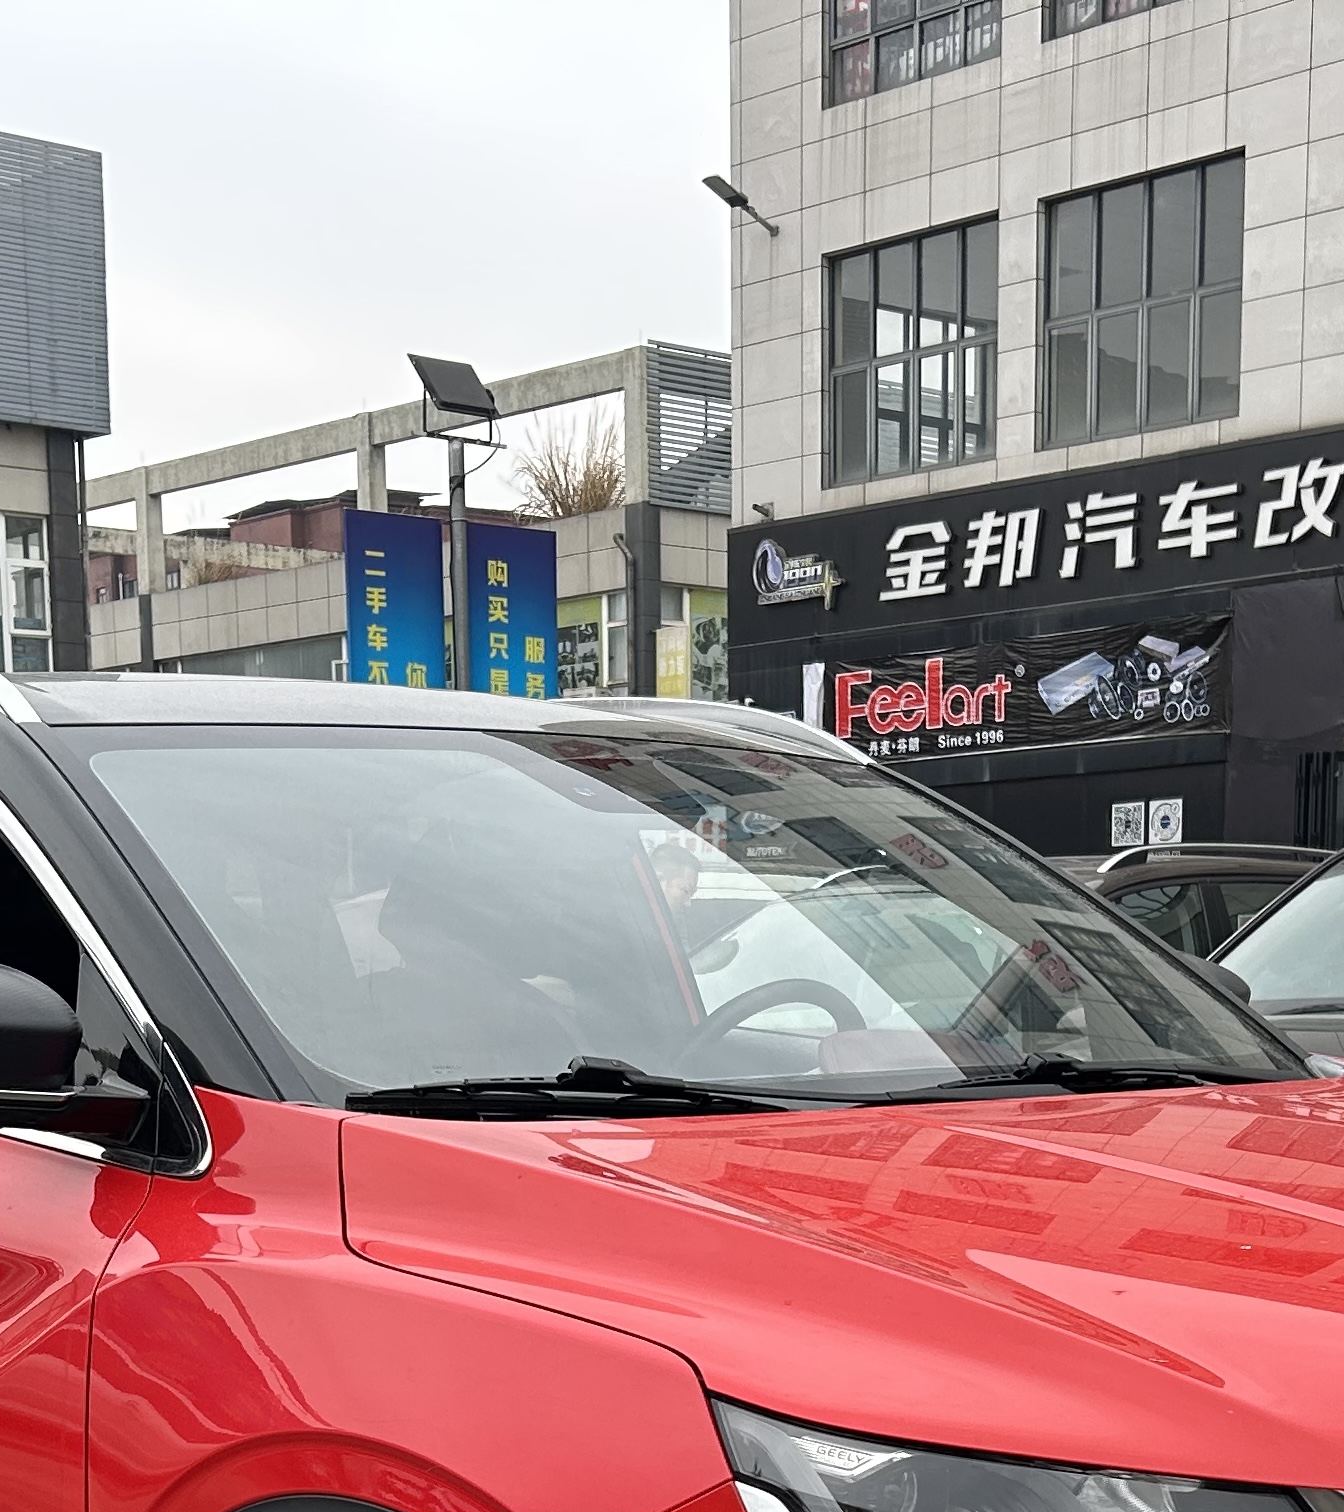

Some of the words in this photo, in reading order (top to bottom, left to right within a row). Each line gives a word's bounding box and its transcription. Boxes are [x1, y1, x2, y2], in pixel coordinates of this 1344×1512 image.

[835, 658, 1011, 739] Feelart
[937, 734, 972, 749] Since
[975, 731, 1004, 745] 1996
